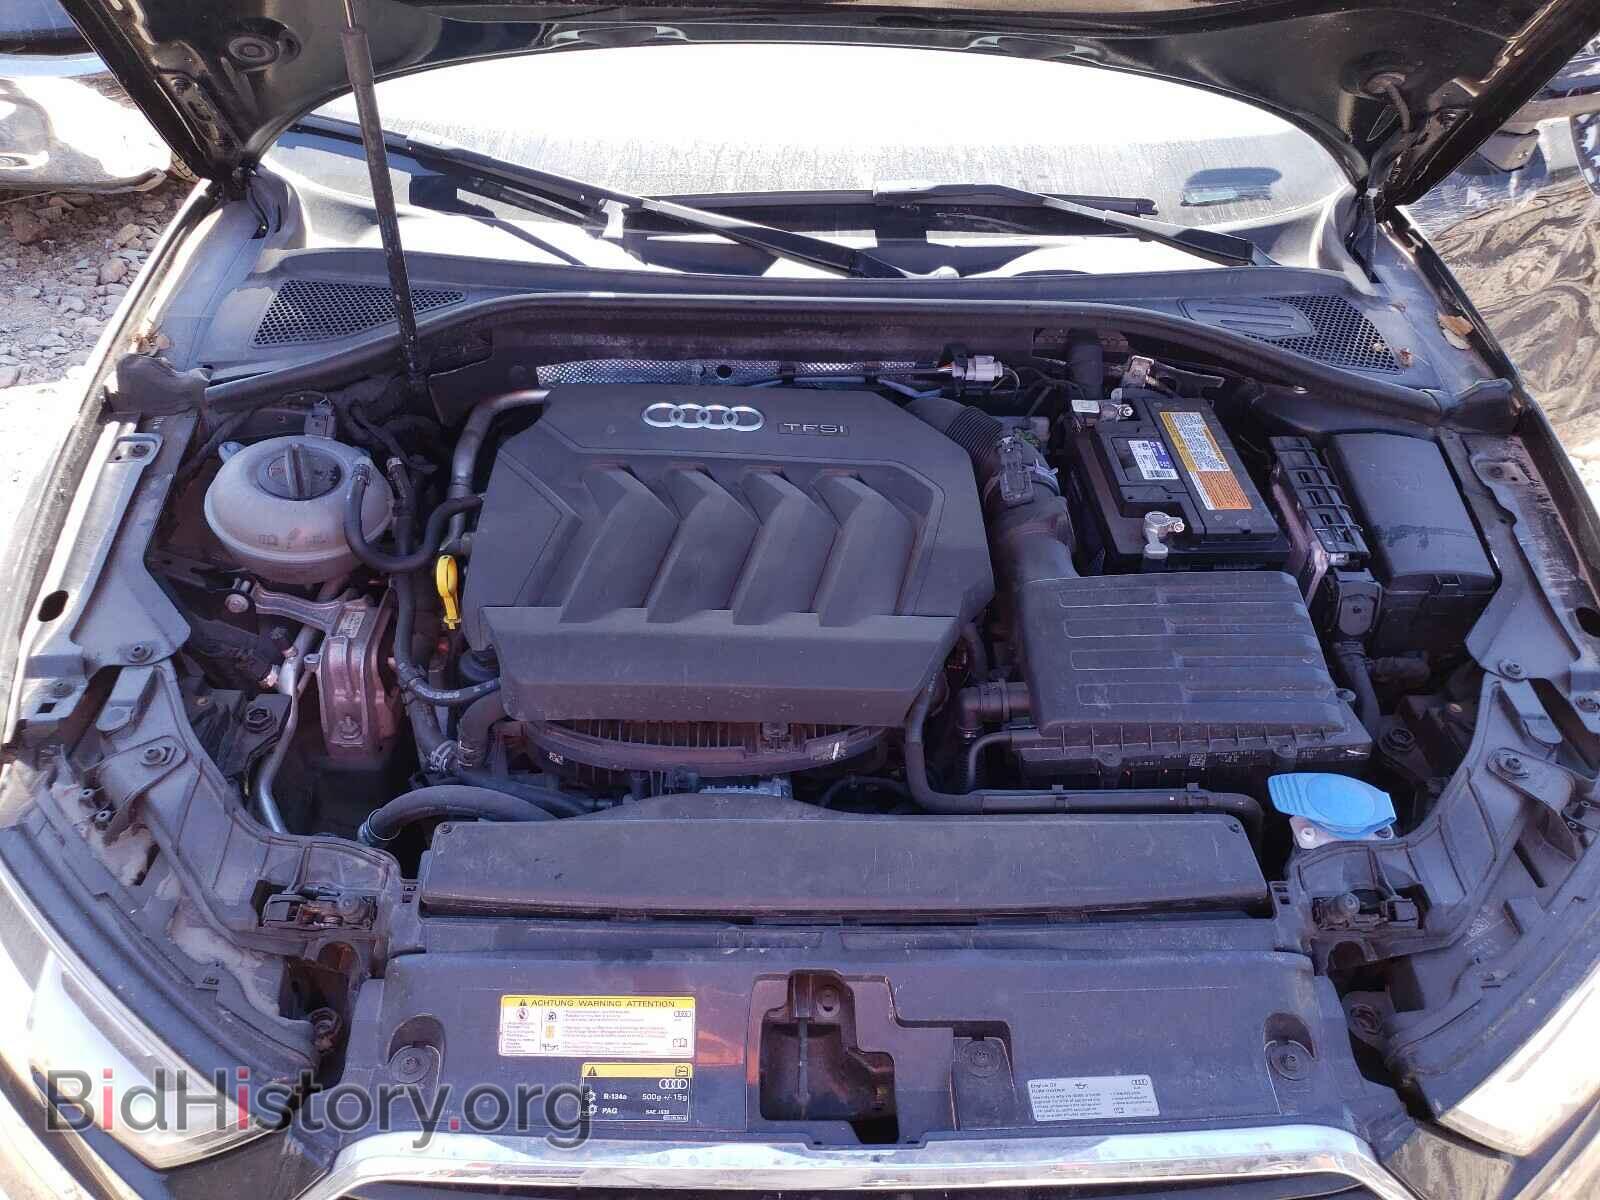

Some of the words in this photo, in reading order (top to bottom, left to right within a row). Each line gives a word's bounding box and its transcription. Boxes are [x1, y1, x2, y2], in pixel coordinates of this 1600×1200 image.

[783, 423, 844, 433] TFSI
[530, 999, 574, 1007] ACHTUNG
[578, 1000, 622, 1008] WARNING
[626, 1000, 675, 1008] ATTENTION
[642, 1093, 661, 1101] 500g
[673, 1093, 687, 1101] 15g
